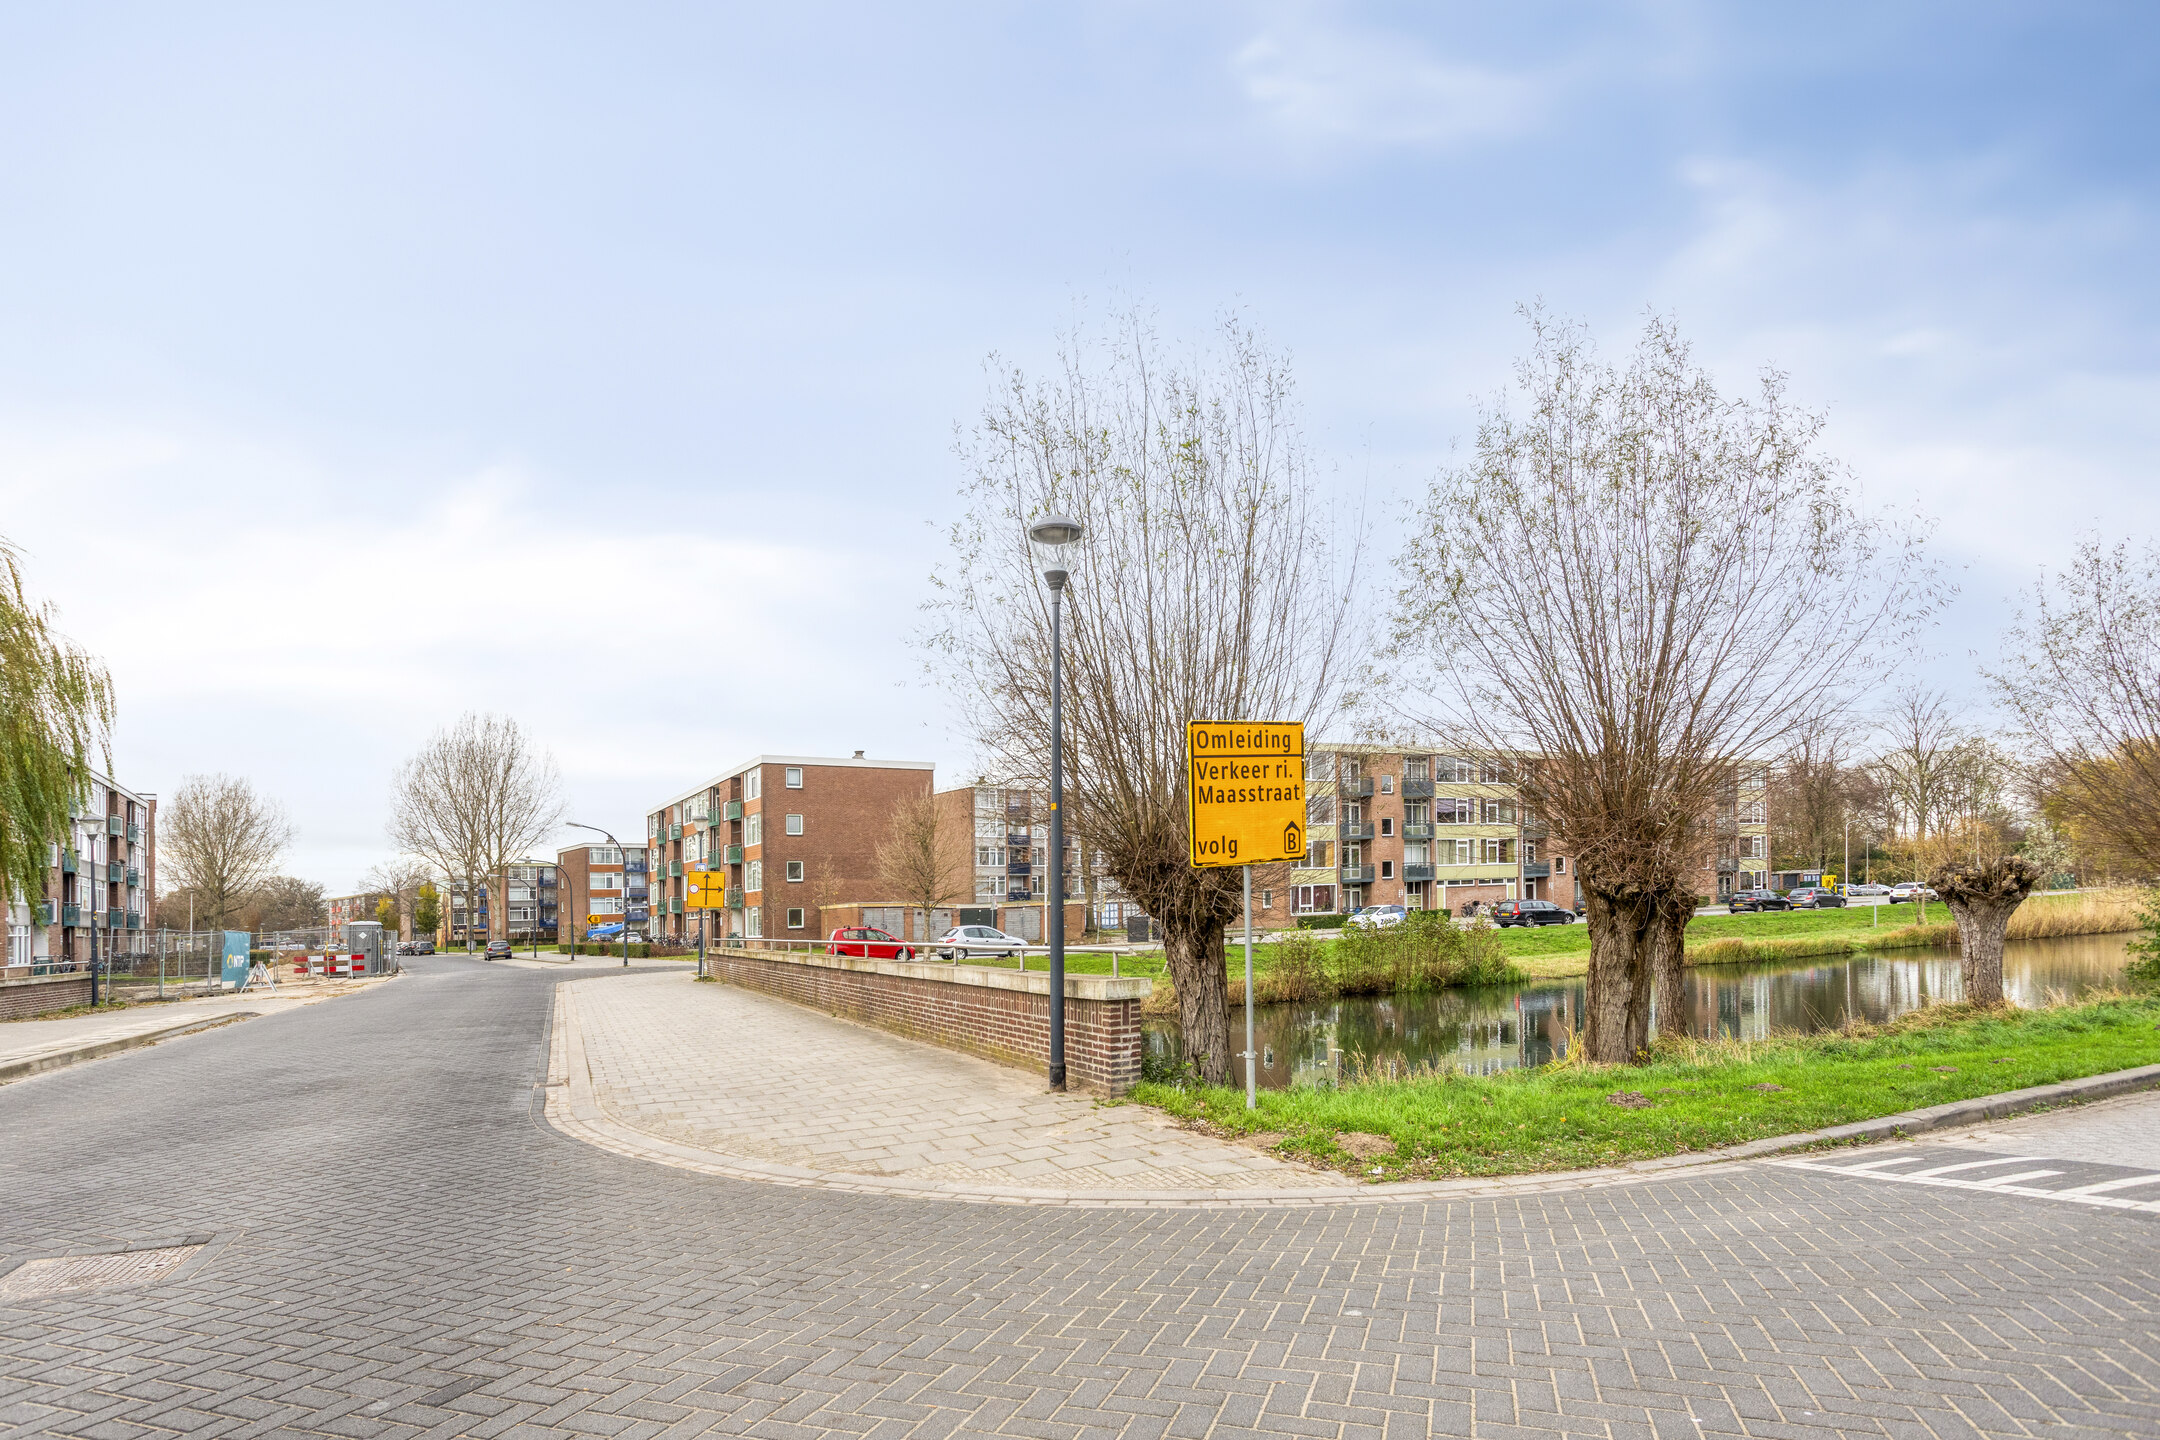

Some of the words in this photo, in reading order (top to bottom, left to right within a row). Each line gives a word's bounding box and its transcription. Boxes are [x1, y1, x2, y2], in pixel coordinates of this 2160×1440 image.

[1196, 729, 1291, 753] Omleiding
[1196, 760, 1270, 780] Verkeer
[1276, 760, 1293, 778] ri.
[1198, 783, 1300, 804] Maasstraat
[1198, 835, 1238, 858] volg
[1288, 833, 1296, 850] B
